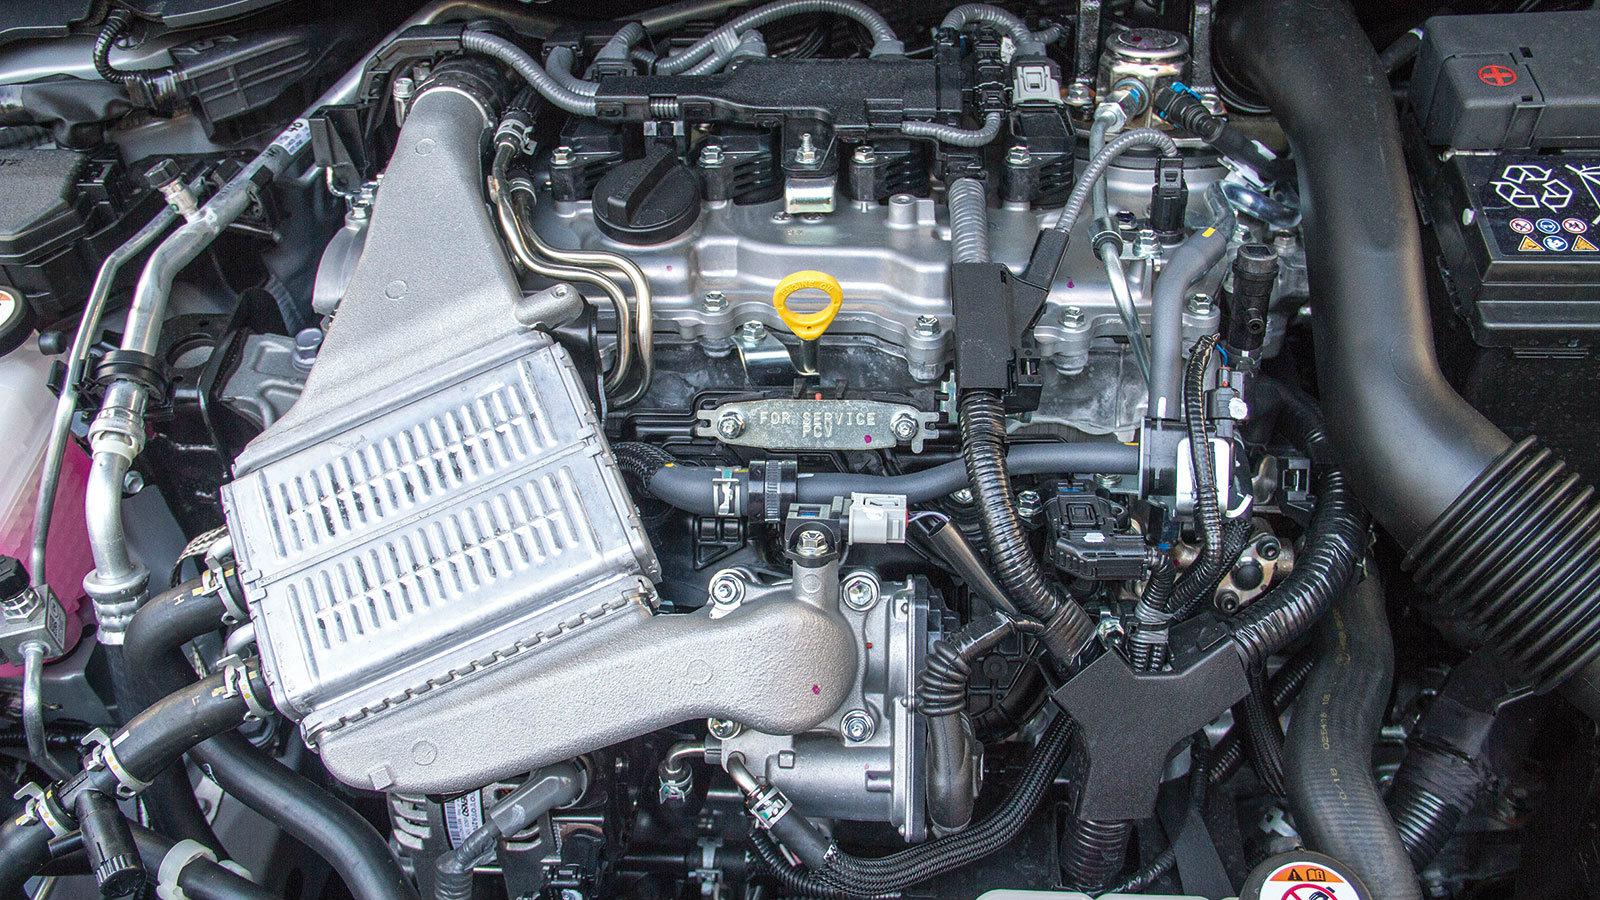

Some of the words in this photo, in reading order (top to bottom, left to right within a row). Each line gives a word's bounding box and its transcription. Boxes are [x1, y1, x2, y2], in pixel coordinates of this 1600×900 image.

[759, 411, 791, 425] FOR
[802, 412, 876, 426] SERVICE
[802, 425, 833, 438] PCV
